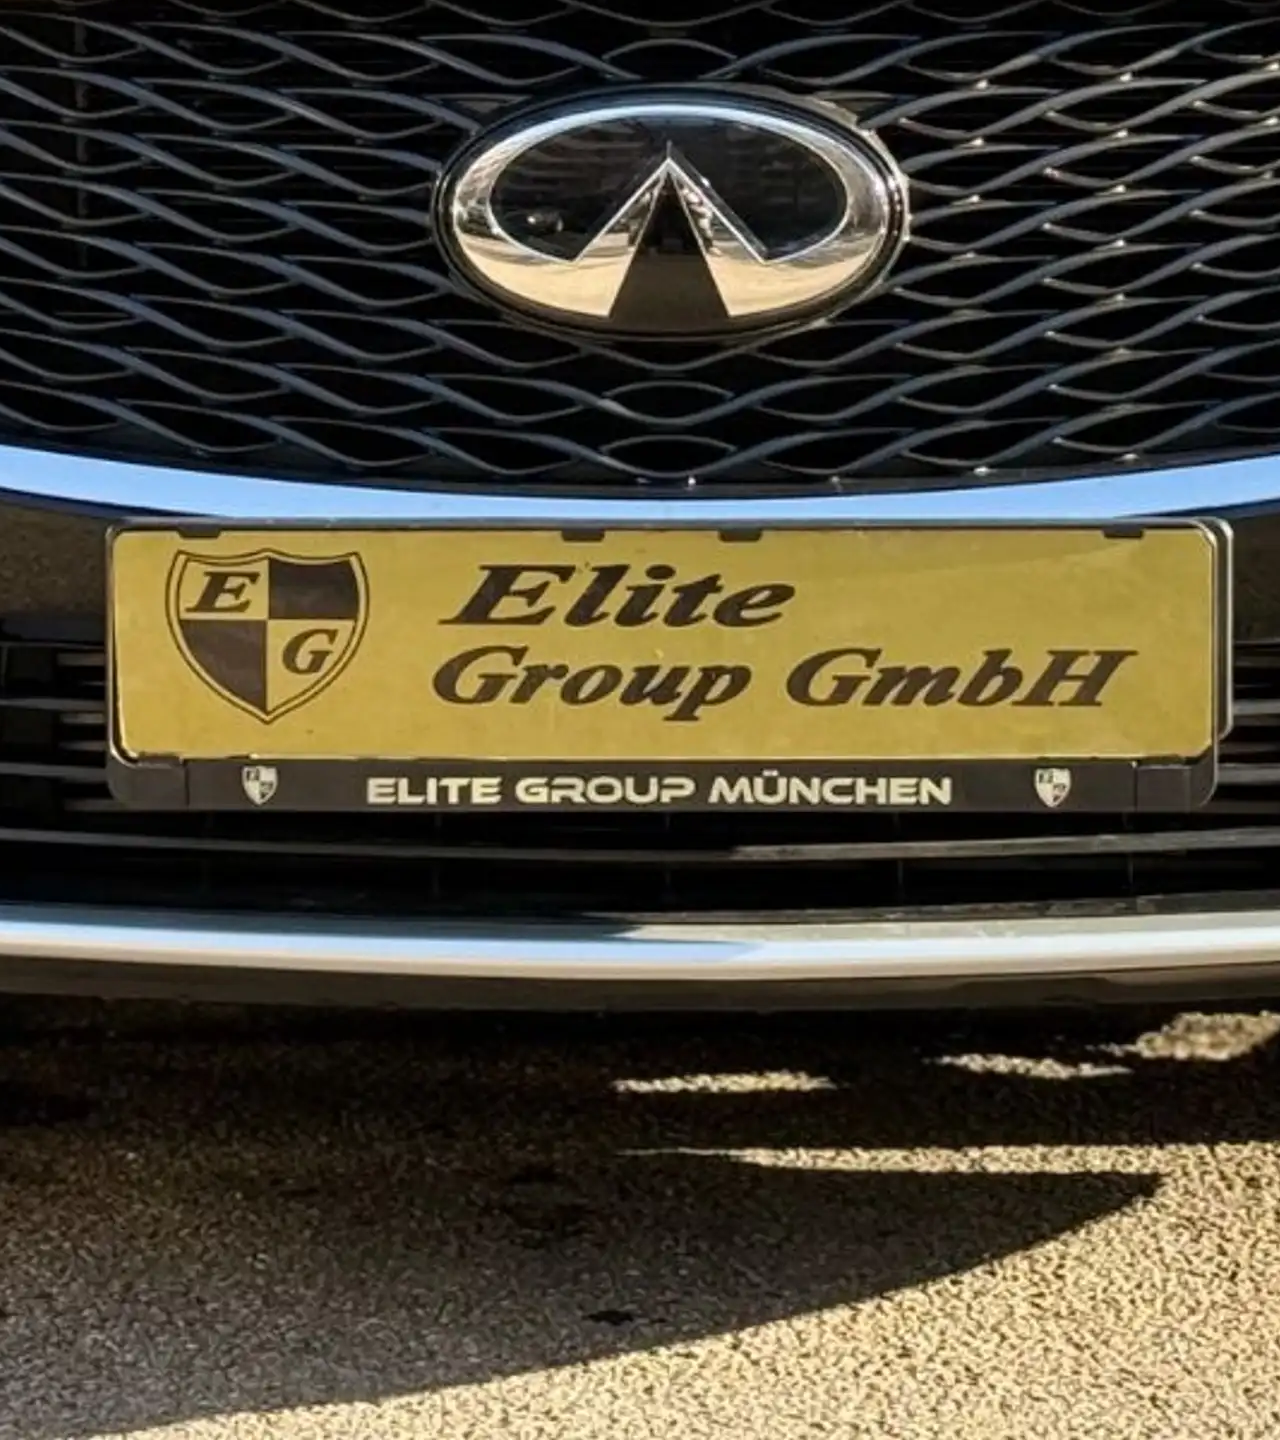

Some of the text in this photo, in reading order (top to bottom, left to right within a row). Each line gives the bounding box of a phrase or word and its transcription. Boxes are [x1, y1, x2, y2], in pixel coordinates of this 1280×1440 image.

[185, 571, 260, 613] E
[437, 563, 796, 627] Elite
[282, 628, 338, 675] G
[432, 645, 1139, 721] Group GmbH
[366, 769, 952, 805] ELITE GROUP MÜNCHEN
